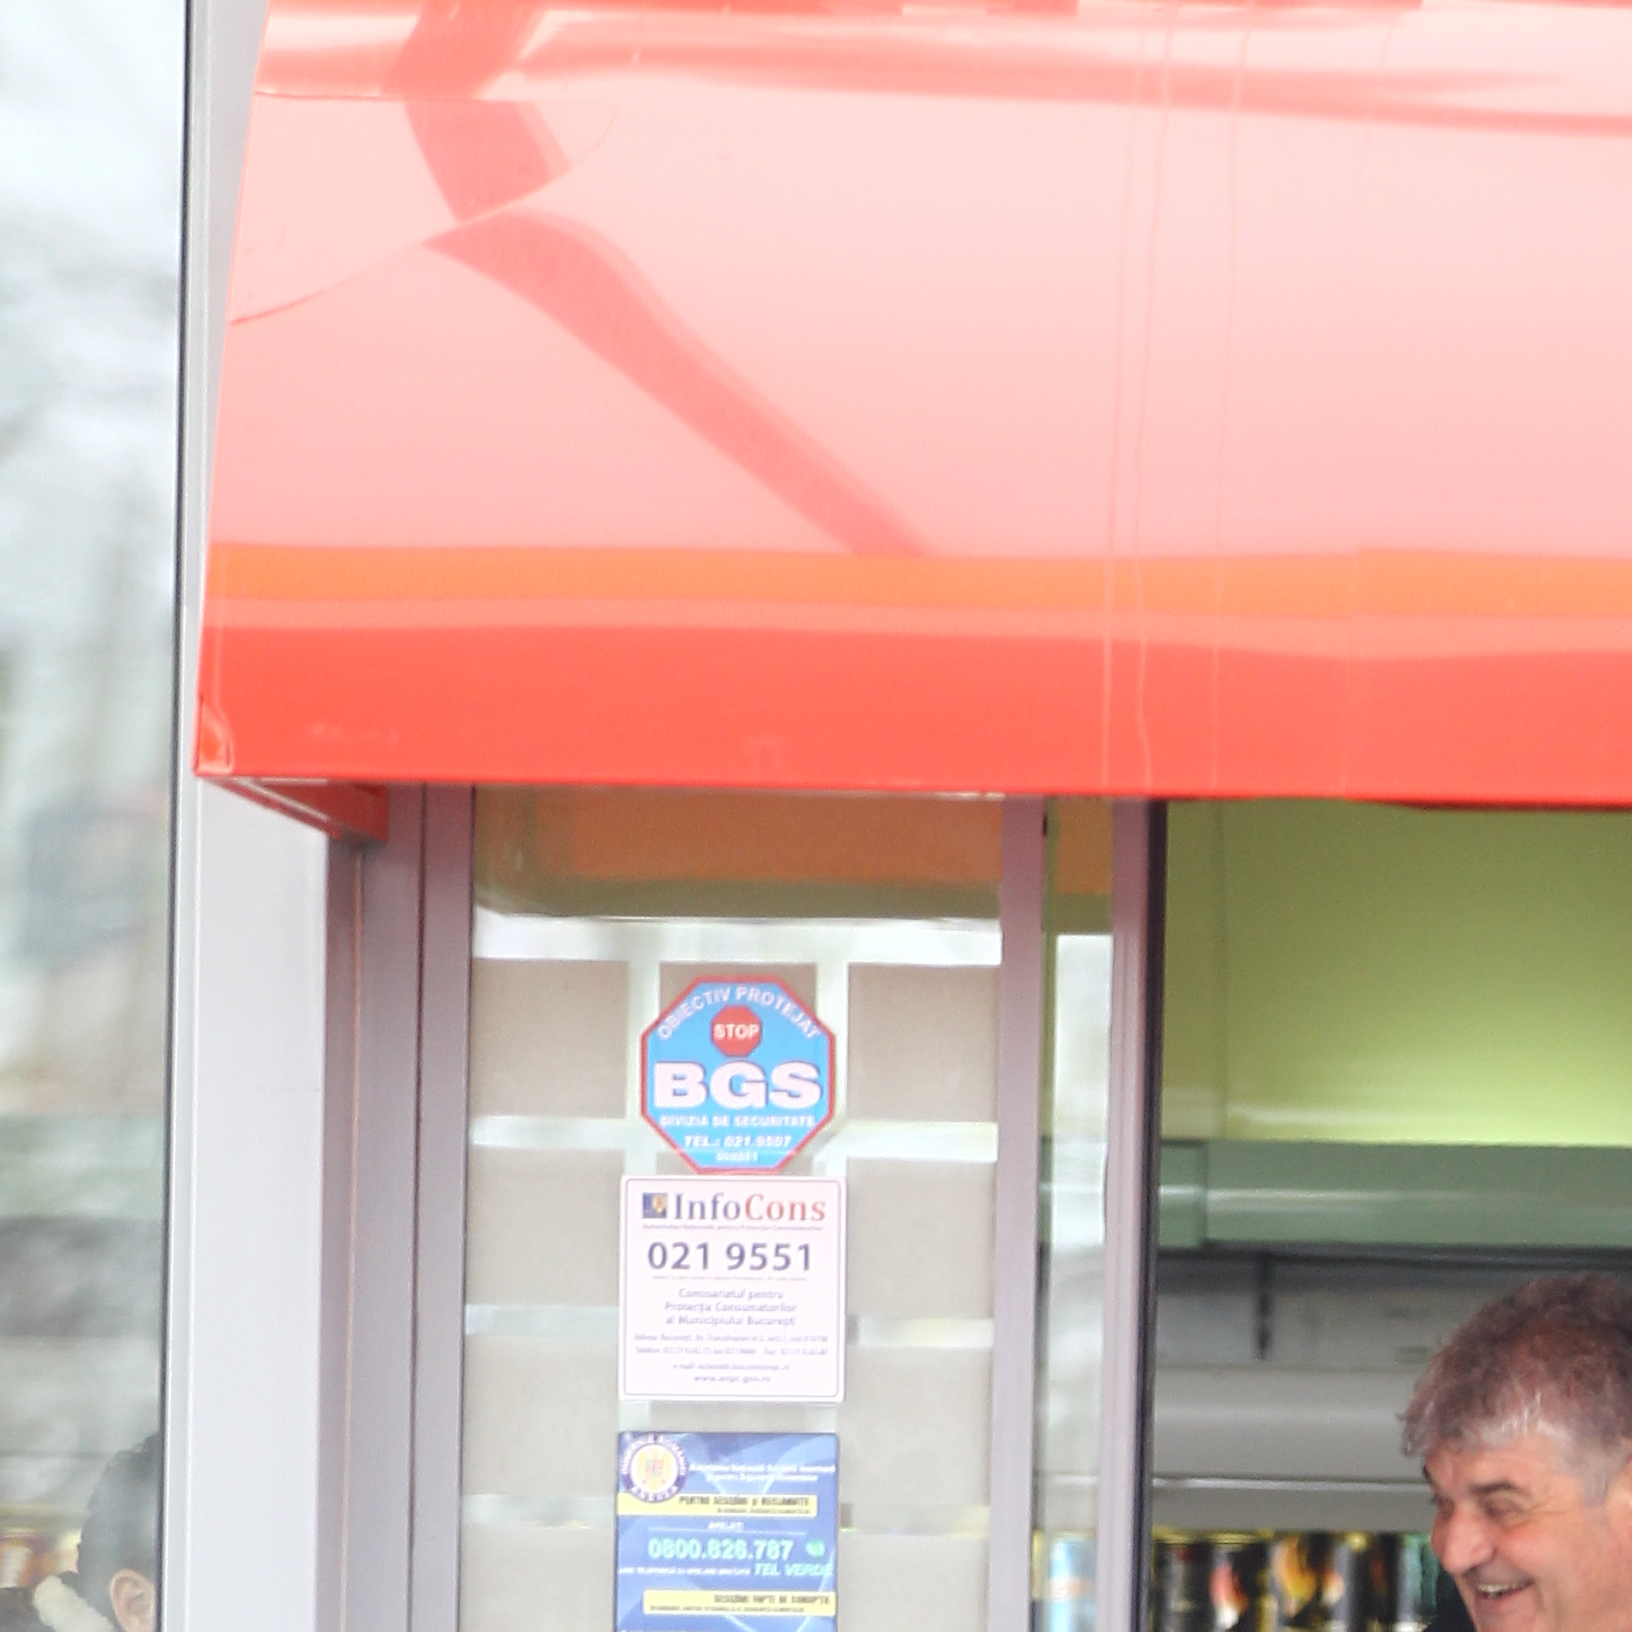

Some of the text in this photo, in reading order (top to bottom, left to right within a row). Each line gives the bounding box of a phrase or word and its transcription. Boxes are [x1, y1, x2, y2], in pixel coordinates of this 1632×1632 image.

[656, 983, 821, 1041] OBIECTIV PROTEJAT
[713, 1023, 759, 1040] STOP
[653, 1060, 823, 1110] BGS
[674, 1192, 827, 1222] InfoCons
[647, 1241, 811, 1272] 021 9551
[753, 1562, 782, 1576] TEL
[785, 1563, 834, 1577] VERDE
